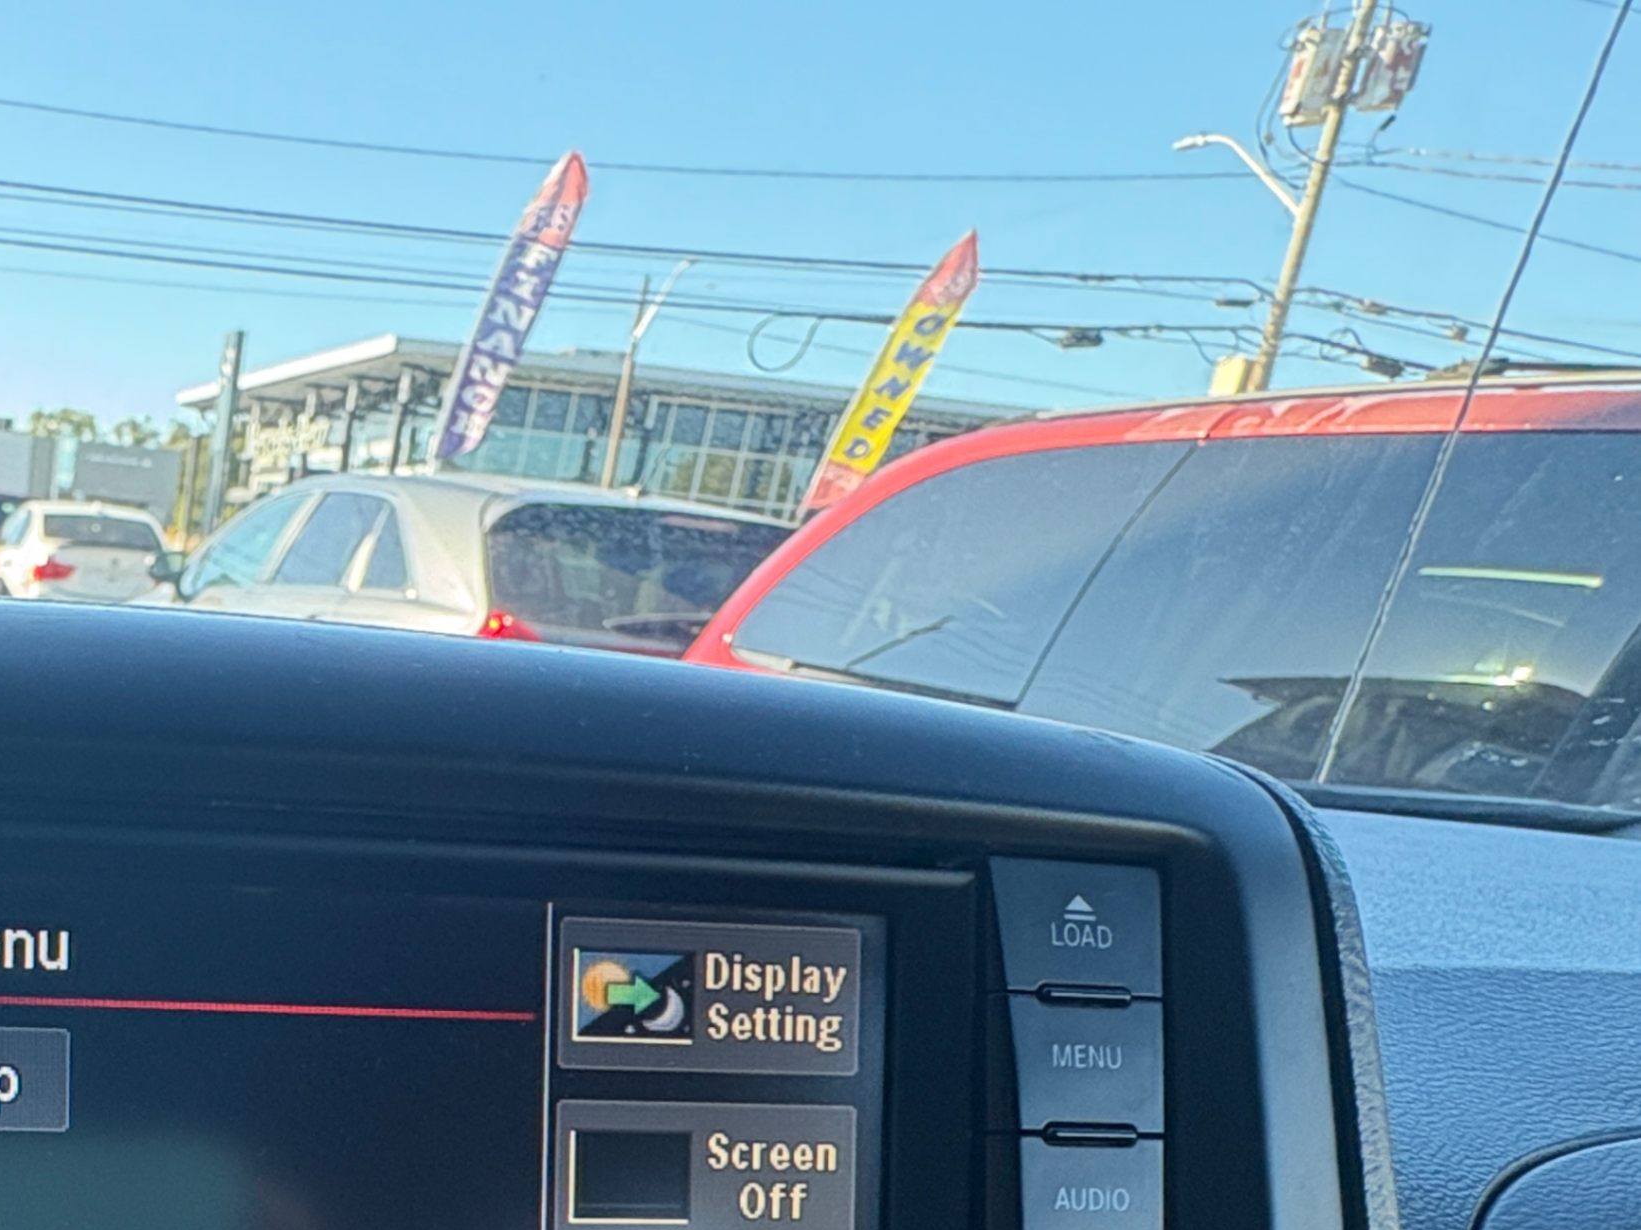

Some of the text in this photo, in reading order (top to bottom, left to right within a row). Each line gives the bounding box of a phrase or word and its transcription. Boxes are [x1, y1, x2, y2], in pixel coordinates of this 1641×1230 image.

[842, 313, 946, 460] OWNED
[1050, 923, 1113, 950] LOAD
[703, 951, 847, 1004] Display
[706, 1003, 844, 1051] Setting
[1052, 1044, 1123, 1069] MENU
[707, 1133, 838, 1172] Screen
[738, 1182, 808, 1220] Off
[1054, 1187, 1131, 1212] AUDIO
